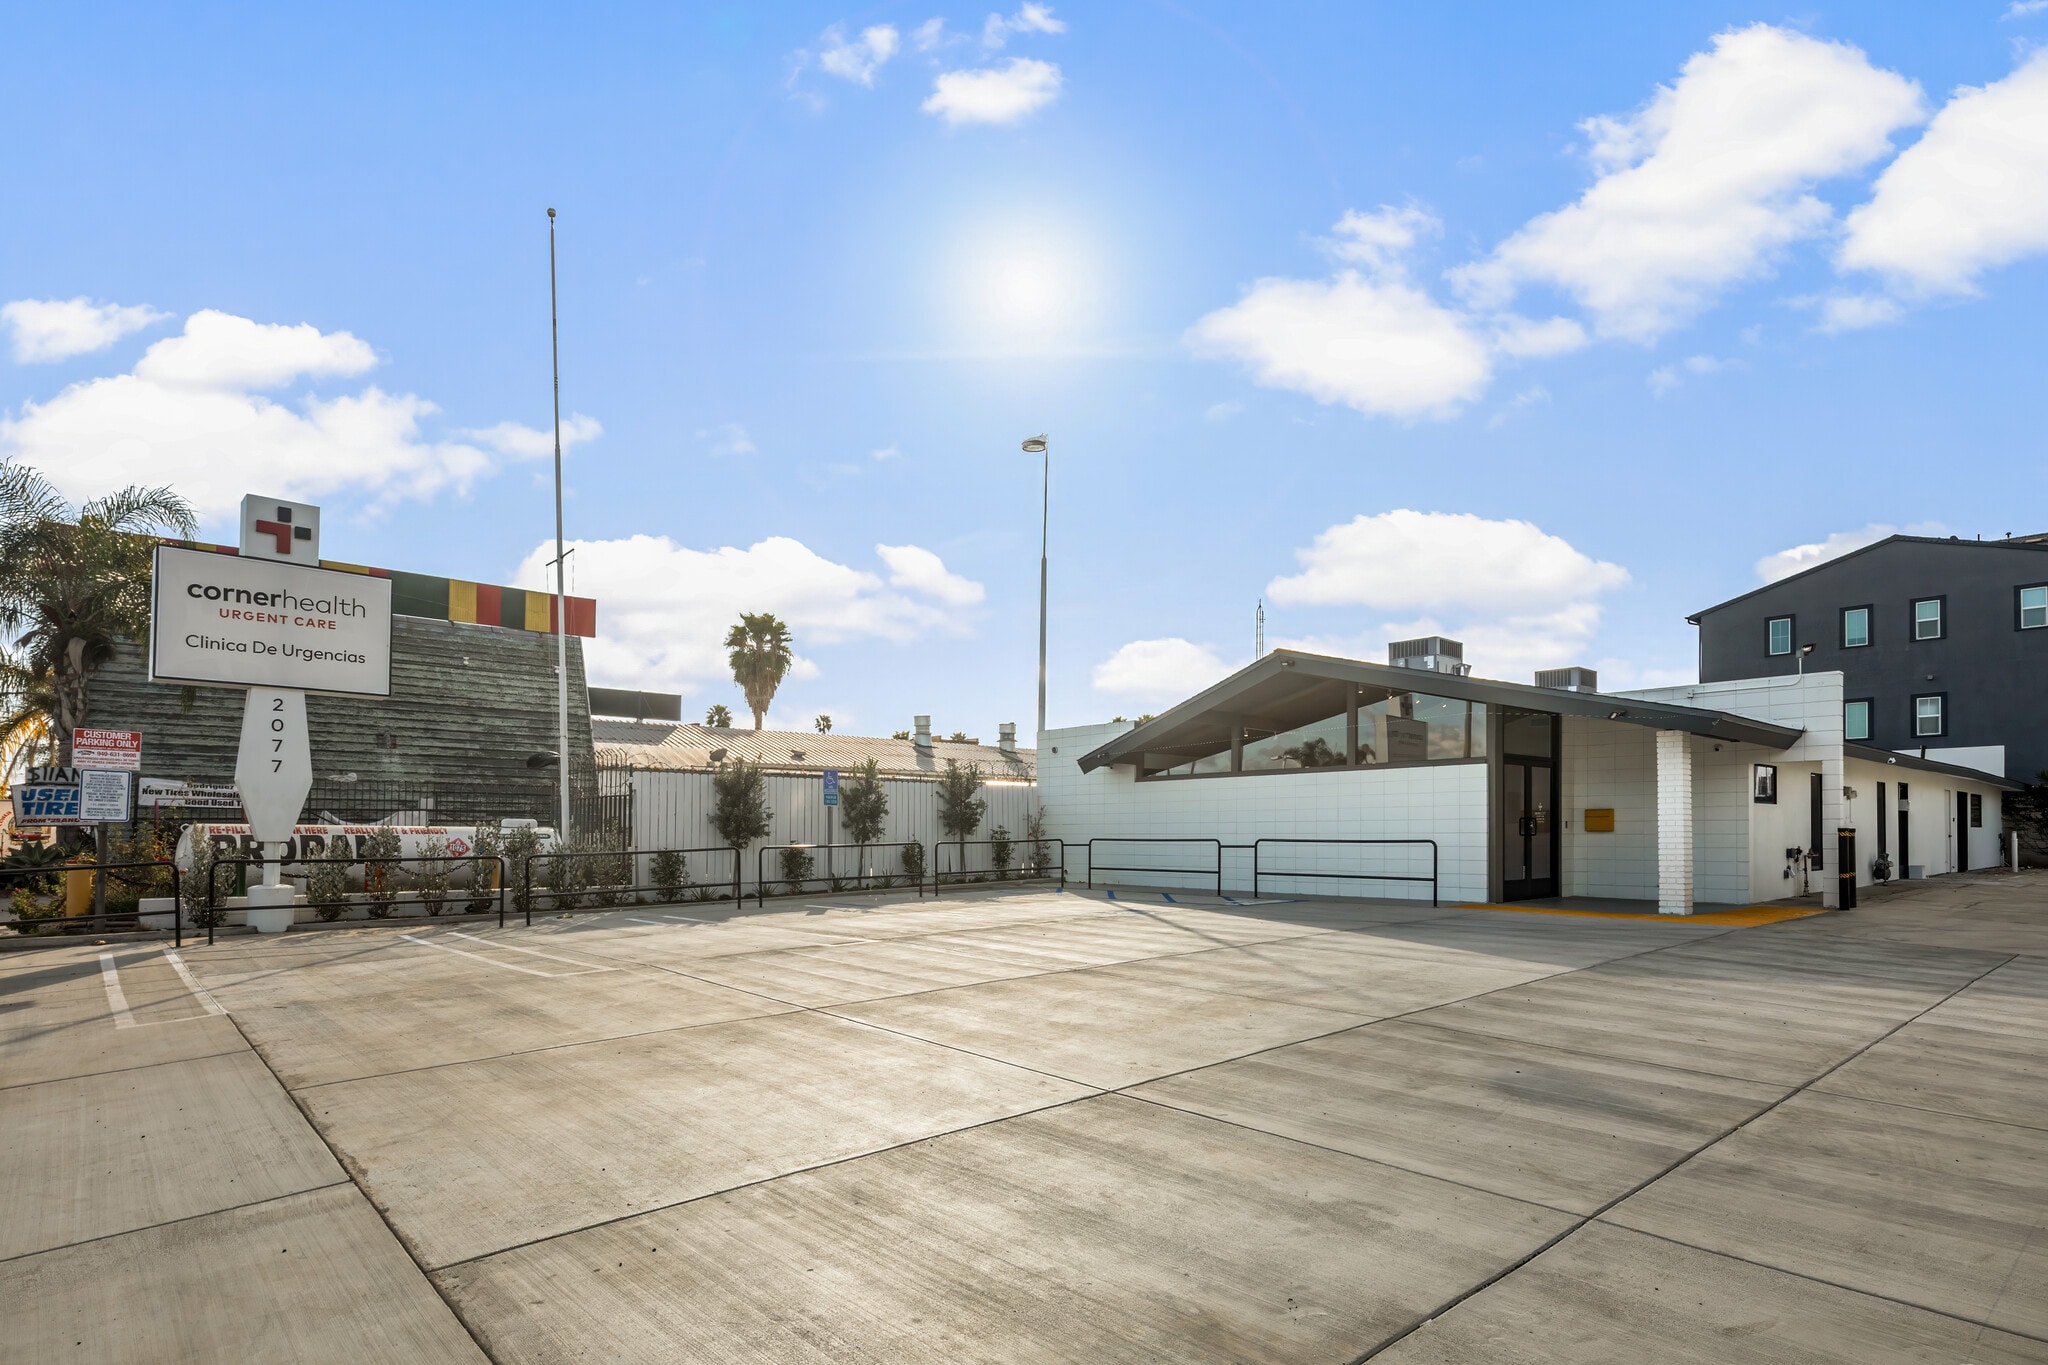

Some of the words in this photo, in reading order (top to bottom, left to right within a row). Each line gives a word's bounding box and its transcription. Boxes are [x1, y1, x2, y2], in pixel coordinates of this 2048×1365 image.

[187, 583, 366, 618] cornerhealth
[219, 608, 288, 625] URGENT
[294, 616, 337, 630] CARE
[185, 634, 247, 653] Clinica
[252, 640, 277, 655] De
[282, 643, 366, 664] Urgencias
[83, 730, 132, 740] CUSTOMER
[271, 698, 284, 773] 2077
[76, 737, 115, 747] PARKING
[116, 740, 139, 748] ONLY
[142, 788, 163, 796] New
[165, 788, 190, 797] Tires
[211, 799, 234, 807] Used
[209, 826, 246, 835] RE-FILL
[305, 826, 329, 835] HERE
[343, 827, 375, 835] REALLY
[401, 827, 408, 835] &
[409, 827, 448, 835] FRIENDLY
